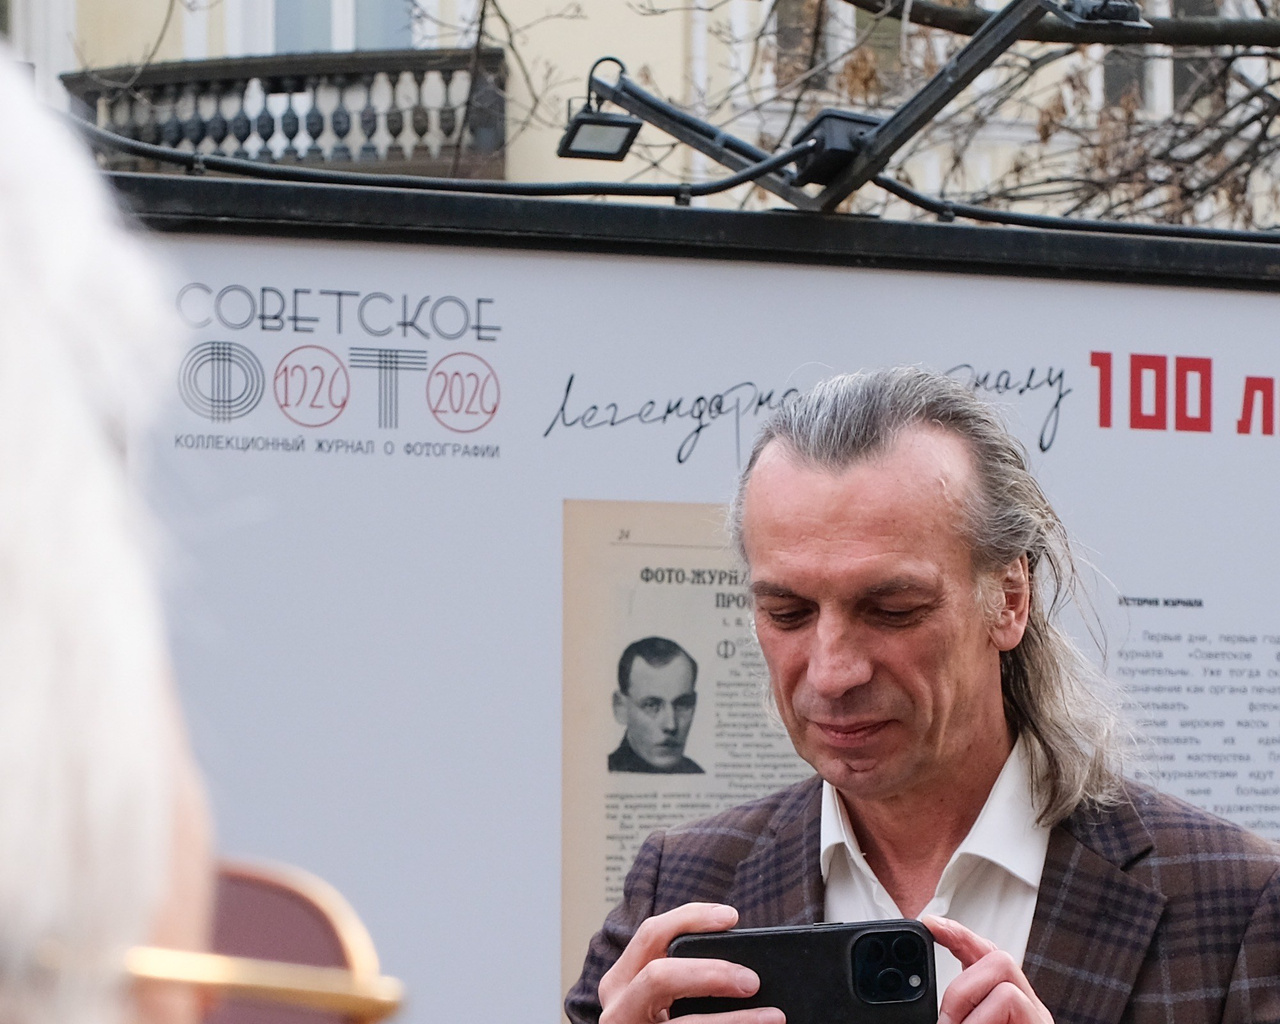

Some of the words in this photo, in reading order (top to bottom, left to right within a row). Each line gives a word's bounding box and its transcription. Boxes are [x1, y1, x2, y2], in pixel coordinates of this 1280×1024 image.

[175, 282, 501, 341] СОВЕТСКОЕ
[543, 373, 798, 469] Легендарн
[944, 363, 1073, 452] налу
[1090, 350, 1212, 433] 100
[174, 434, 305, 452] КОЛЛЕКЦИОННЫЙ
[315, 438, 375, 455] ЖУРНАЛ
[384, 440, 395, 456] О
[403, 441, 500, 458] ФОТОГРАФИИ
[715, 592, 751, 609] ПРО
